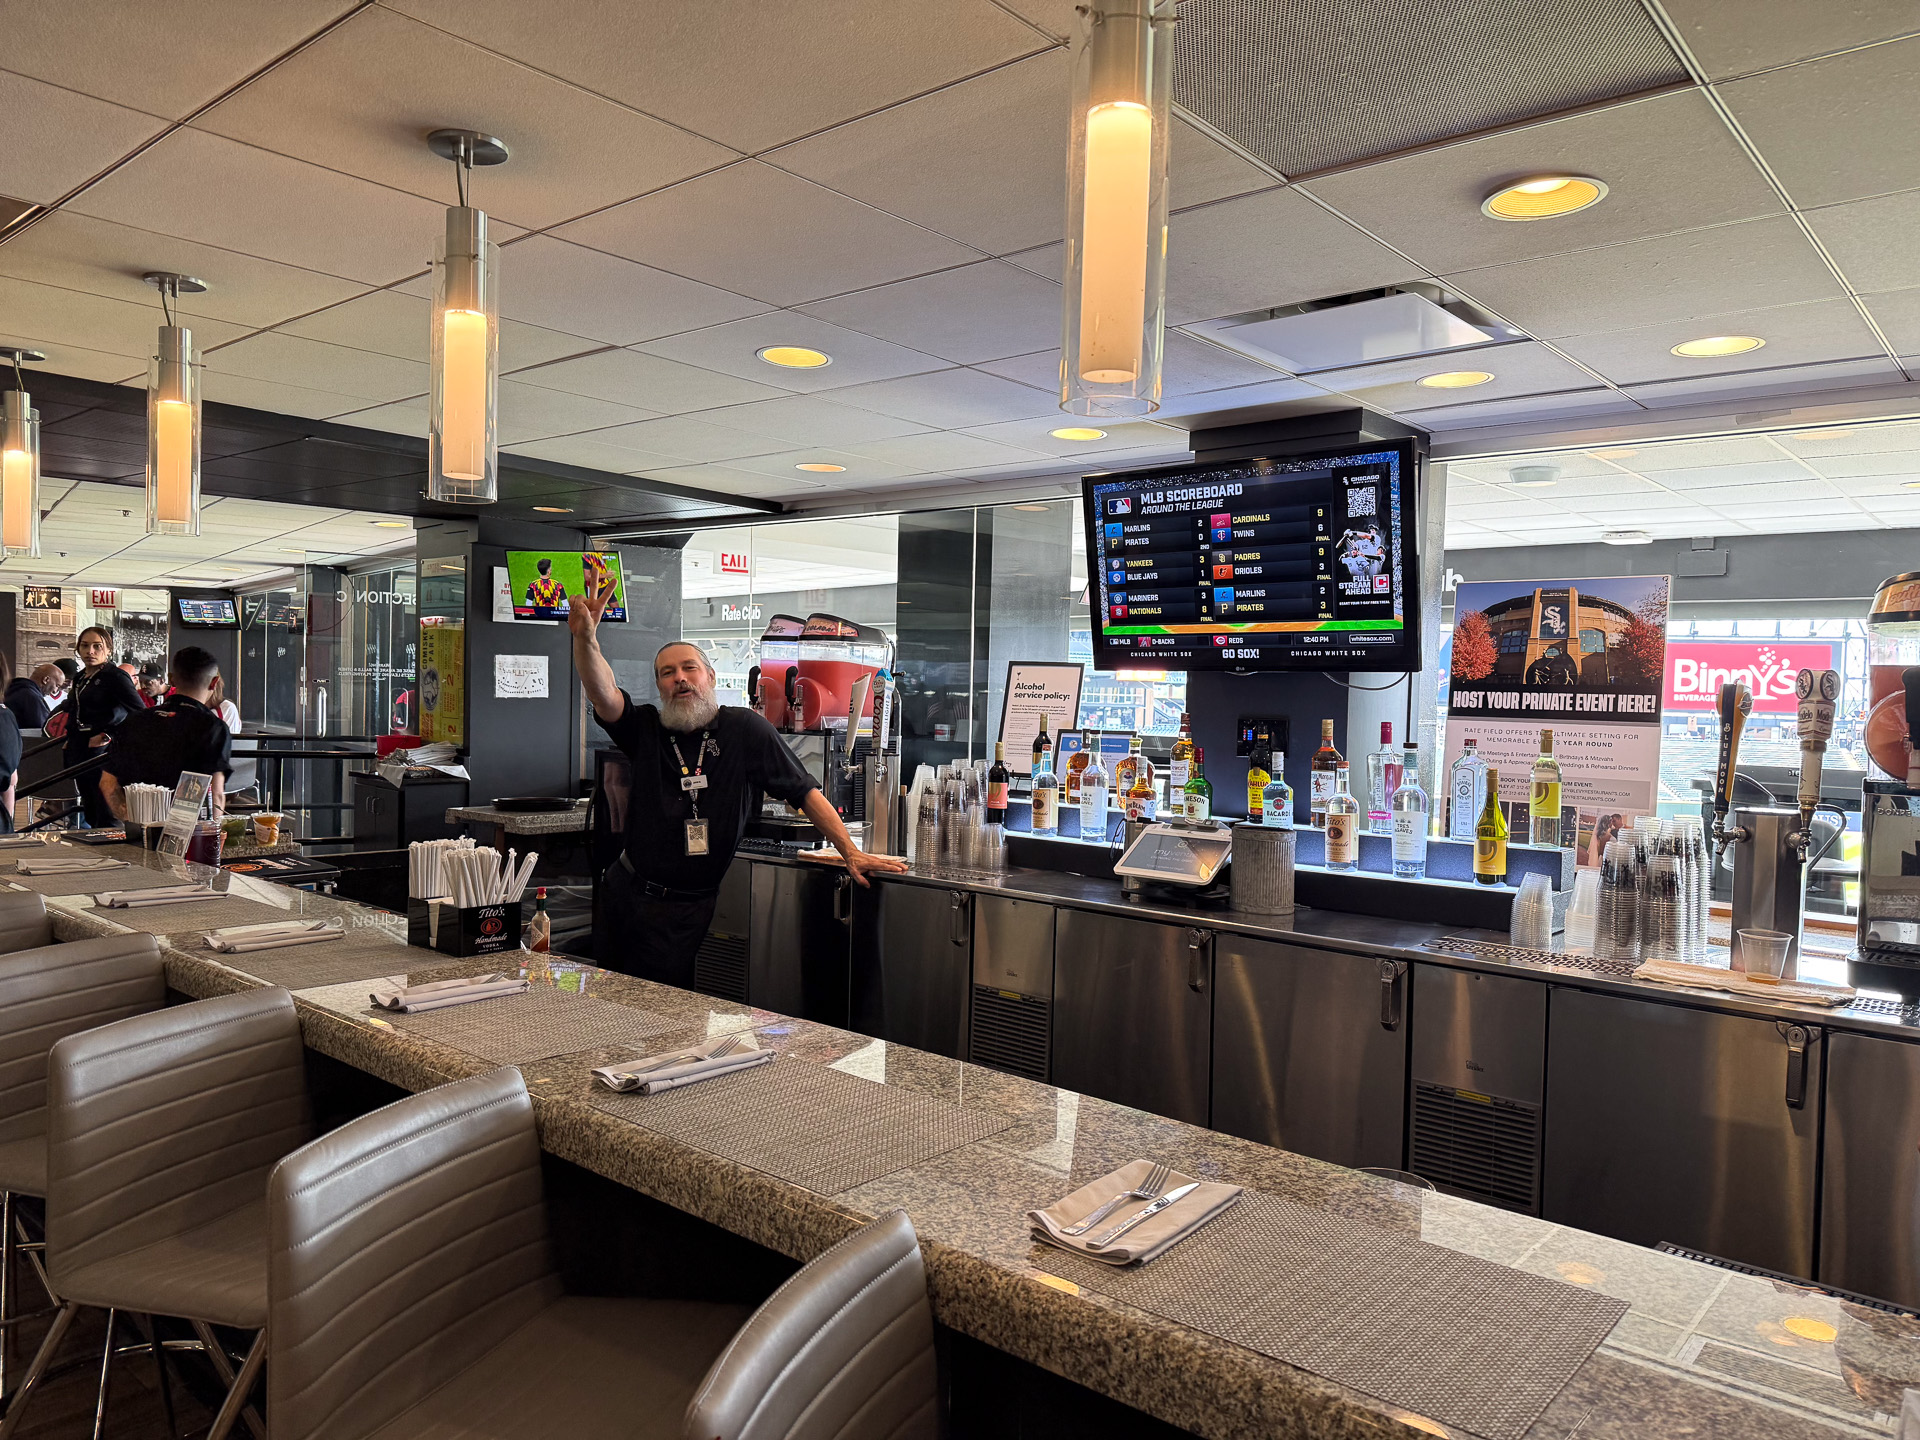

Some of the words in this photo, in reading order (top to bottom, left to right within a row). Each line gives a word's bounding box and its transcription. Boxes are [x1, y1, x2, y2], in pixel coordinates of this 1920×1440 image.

[1140, 491, 1164, 504] MLB
[1166, 483, 1243, 502] SCOREBOARD
[1141, 504, 1174, 515] AROUND
[1175, 502, 1190, 511] THE
[1192, 499, 1224, 510] LEAGUE
[1232, 514, 1270, 524] CARDINALS
[1124, 524, 1151, 533] MARLINS
[1233, 530, 1255, 538] TWINS
[1125, 538, 1149, 546] PIRATES
[1234, 552, 1261, 560] PADRES
[1235, 567, 1262, 575] ORIOLES
[92, 590, 116, 604] EXIT
[1236, 589, 1266, 598] MARLINS
[722, 604, 741, 621] Rate
[1222, 649, 1235, 658] GO
[1238, 649, 1260, 658] SOX!
[1044, 692, 1070, 701] policy:
[1452, 691, 1485, 708] HOST
[1486, 692, 1520, 710] YOUR
[1522, 692, 1573, 711] PRIVATE
[1575, 694, 1615, 712] EVENT
[1617, 694, 1656, 713] HERE!
[872, 695, 883, 740] Coors
[1718, 762, 1727, 793] MOON
[1326, 817, 1345, 825] Tito's
[478, 906, 505, 918] Tito's
[475, 932, 508, 944] Handmade
